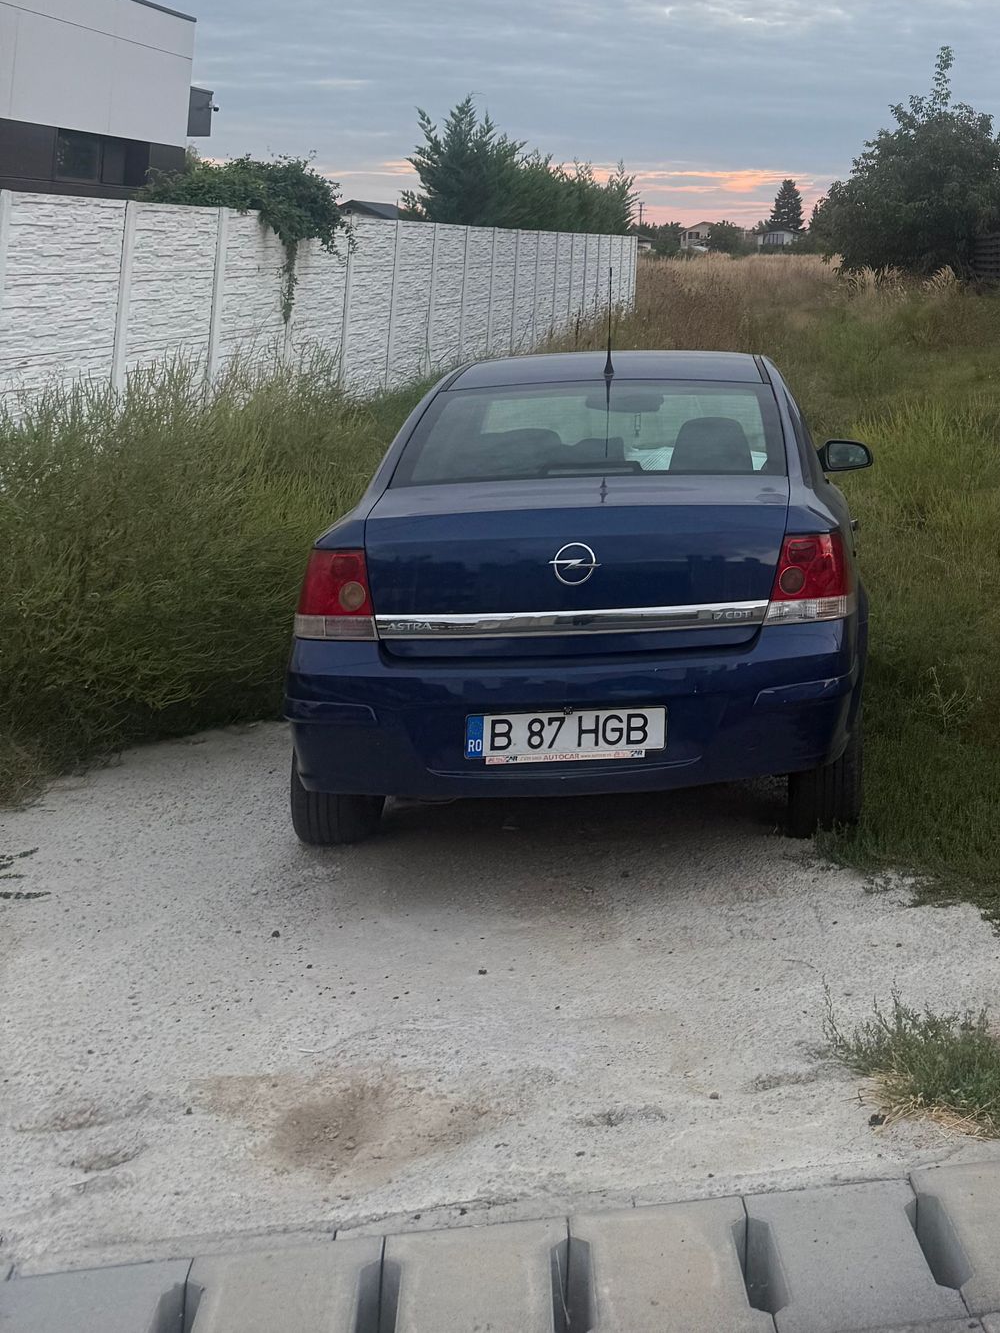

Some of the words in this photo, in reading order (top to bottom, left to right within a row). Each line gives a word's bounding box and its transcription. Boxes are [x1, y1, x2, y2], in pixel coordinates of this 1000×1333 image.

[387, 622, 432, 631] ASTRA
[489, 718, 513, 752] B
[527, 717, 566, 750] 87
[577, 713, 649, 748] HGB
[468, 739, 482, 752] RO
[543, 752, 580, 761] AUTOCAR
